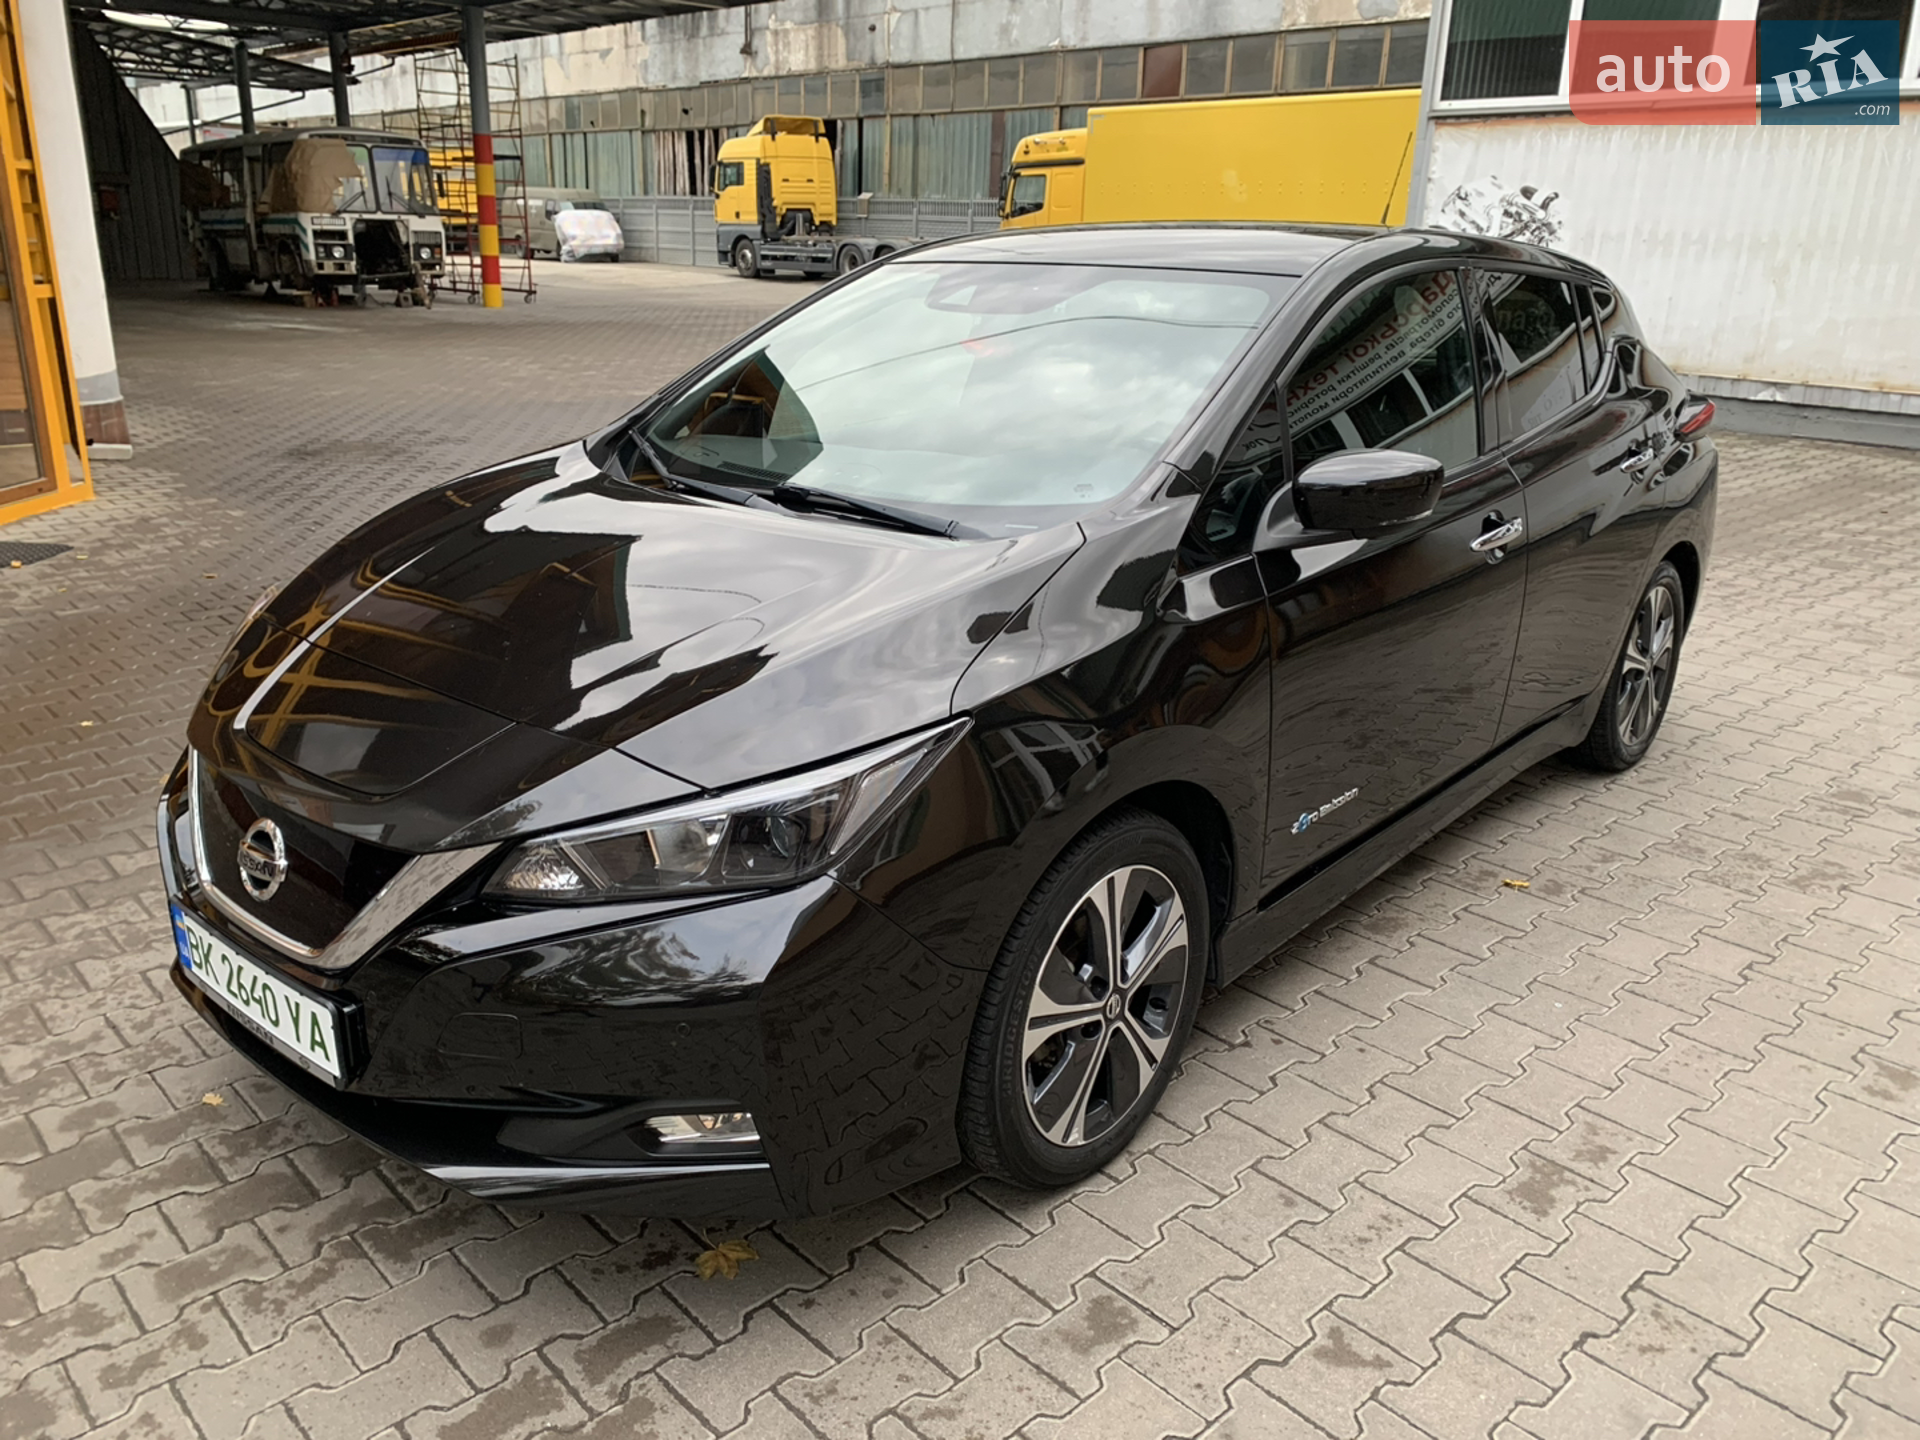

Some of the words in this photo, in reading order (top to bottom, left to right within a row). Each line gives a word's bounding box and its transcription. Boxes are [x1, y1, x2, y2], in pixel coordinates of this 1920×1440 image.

[185, 924, 220, 986] BK
[221, 953, 280, 1028] 2640
[284, 994, 331, 1062] YA
